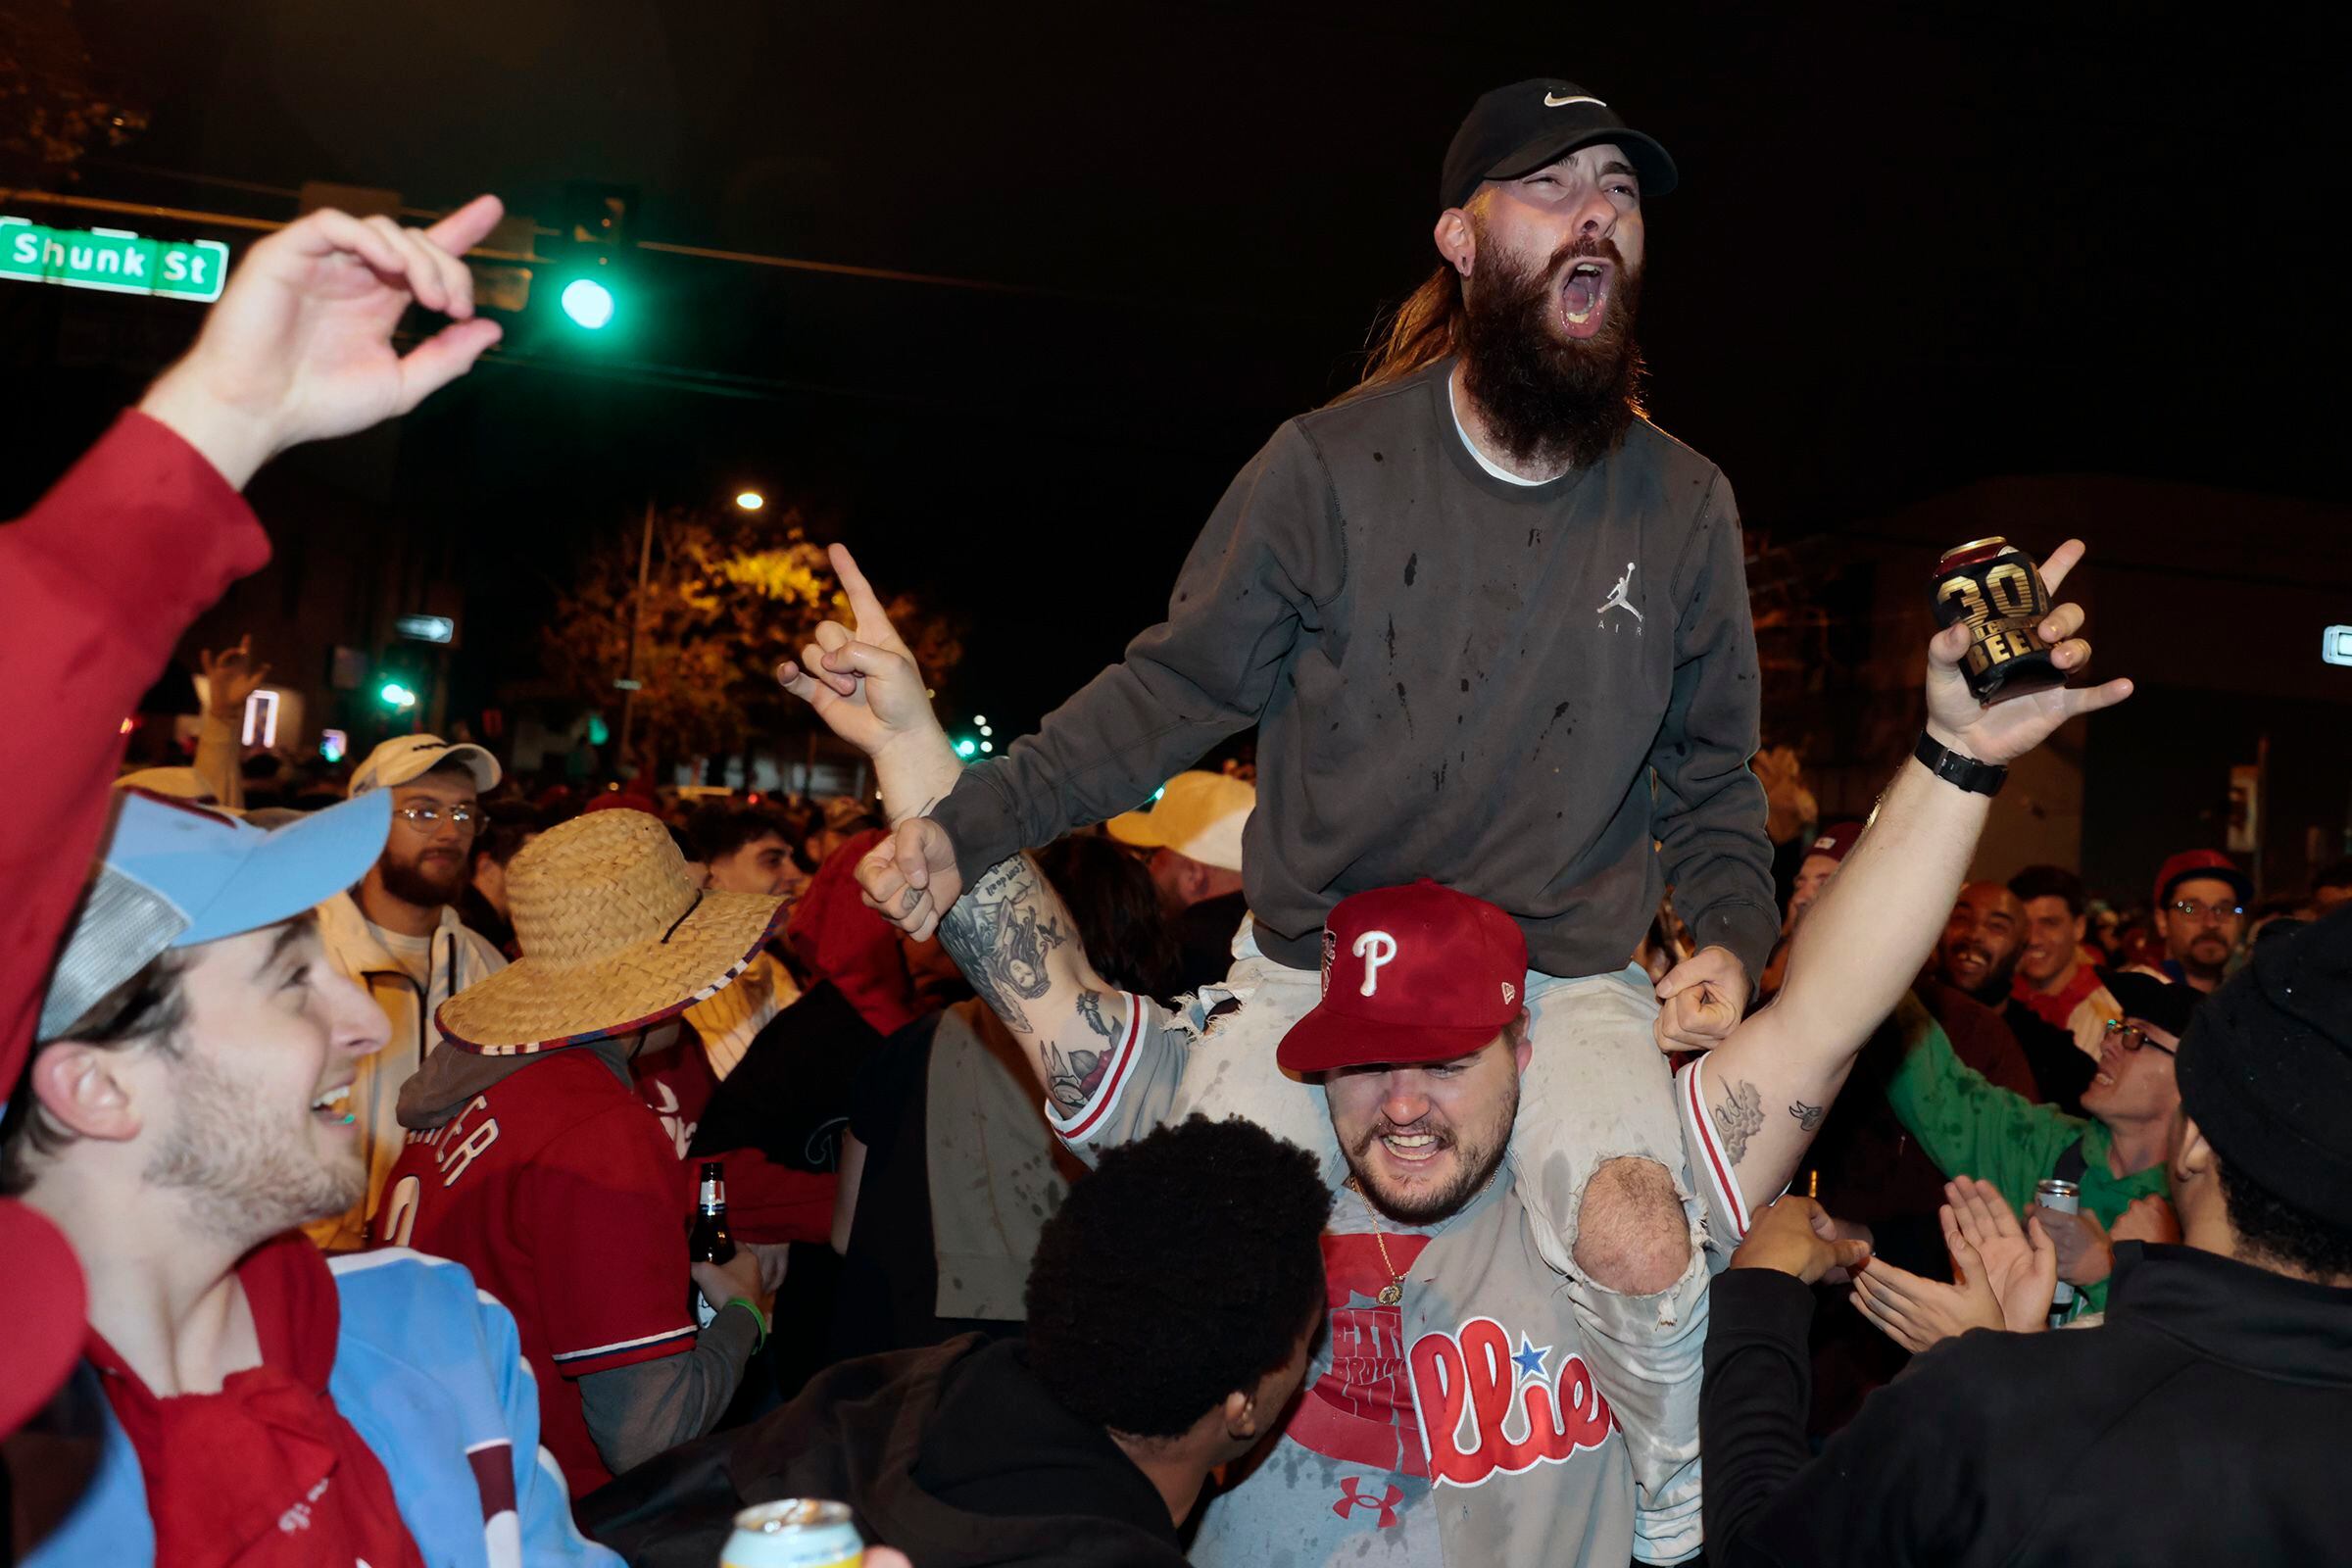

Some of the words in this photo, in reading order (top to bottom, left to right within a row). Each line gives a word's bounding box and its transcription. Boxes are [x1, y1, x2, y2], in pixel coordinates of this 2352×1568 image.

[13, 231, 145, 277] Shunk
[163, 250, 207, 284] St
[1597, 619, 1642, 636] AIR
[1936, 563, 2034, 629] 30
[1352, 930, 1397, 997] P
[1406, 1316, 1623, 1490] llie
